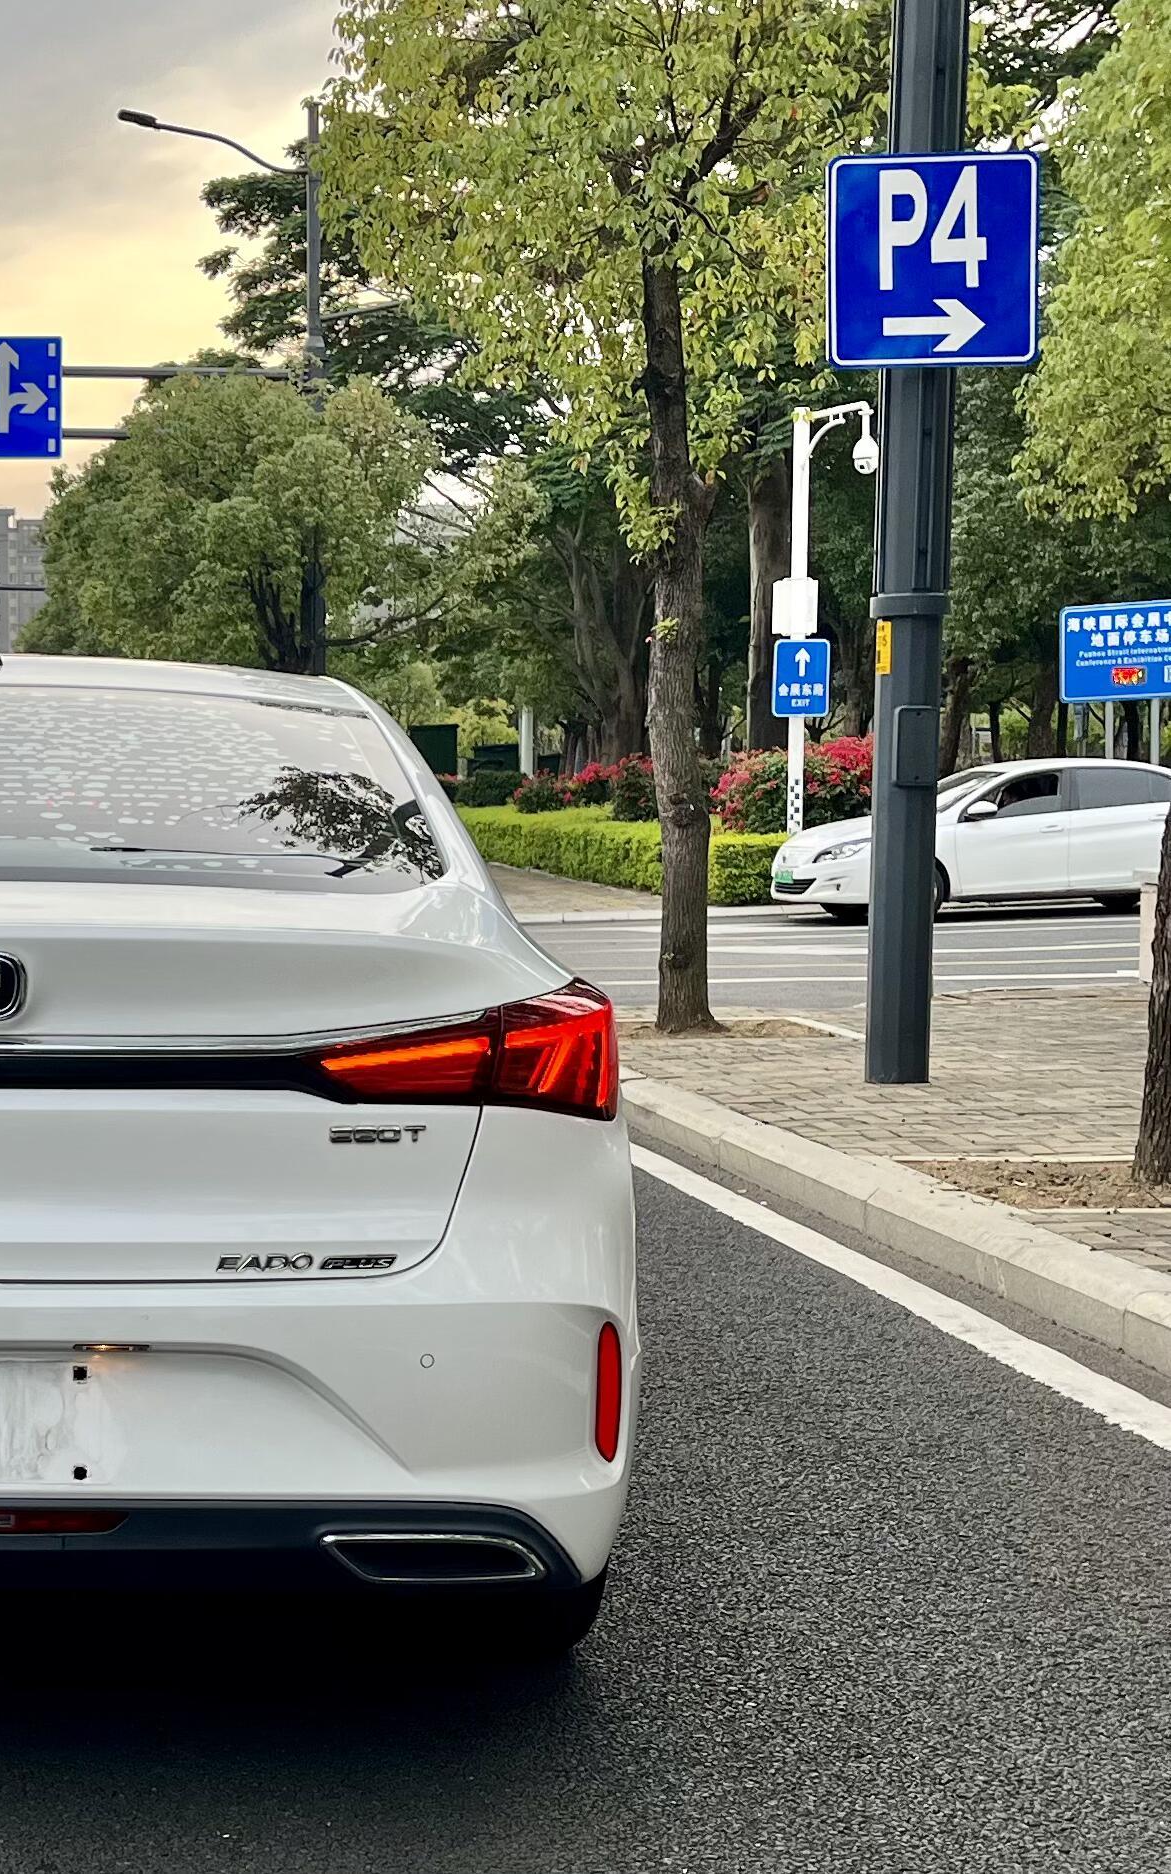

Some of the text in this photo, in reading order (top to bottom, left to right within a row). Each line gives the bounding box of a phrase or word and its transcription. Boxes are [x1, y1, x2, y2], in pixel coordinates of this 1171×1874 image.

[879, 165, 988, 291] P4
[1090, 628, 1170, 647] 地面停车场
[1075, 658, 1116, 667] Conference
[791, 699, 810, 707] EXIT
[215, 1252, 395, 1273] EADO PLUS
